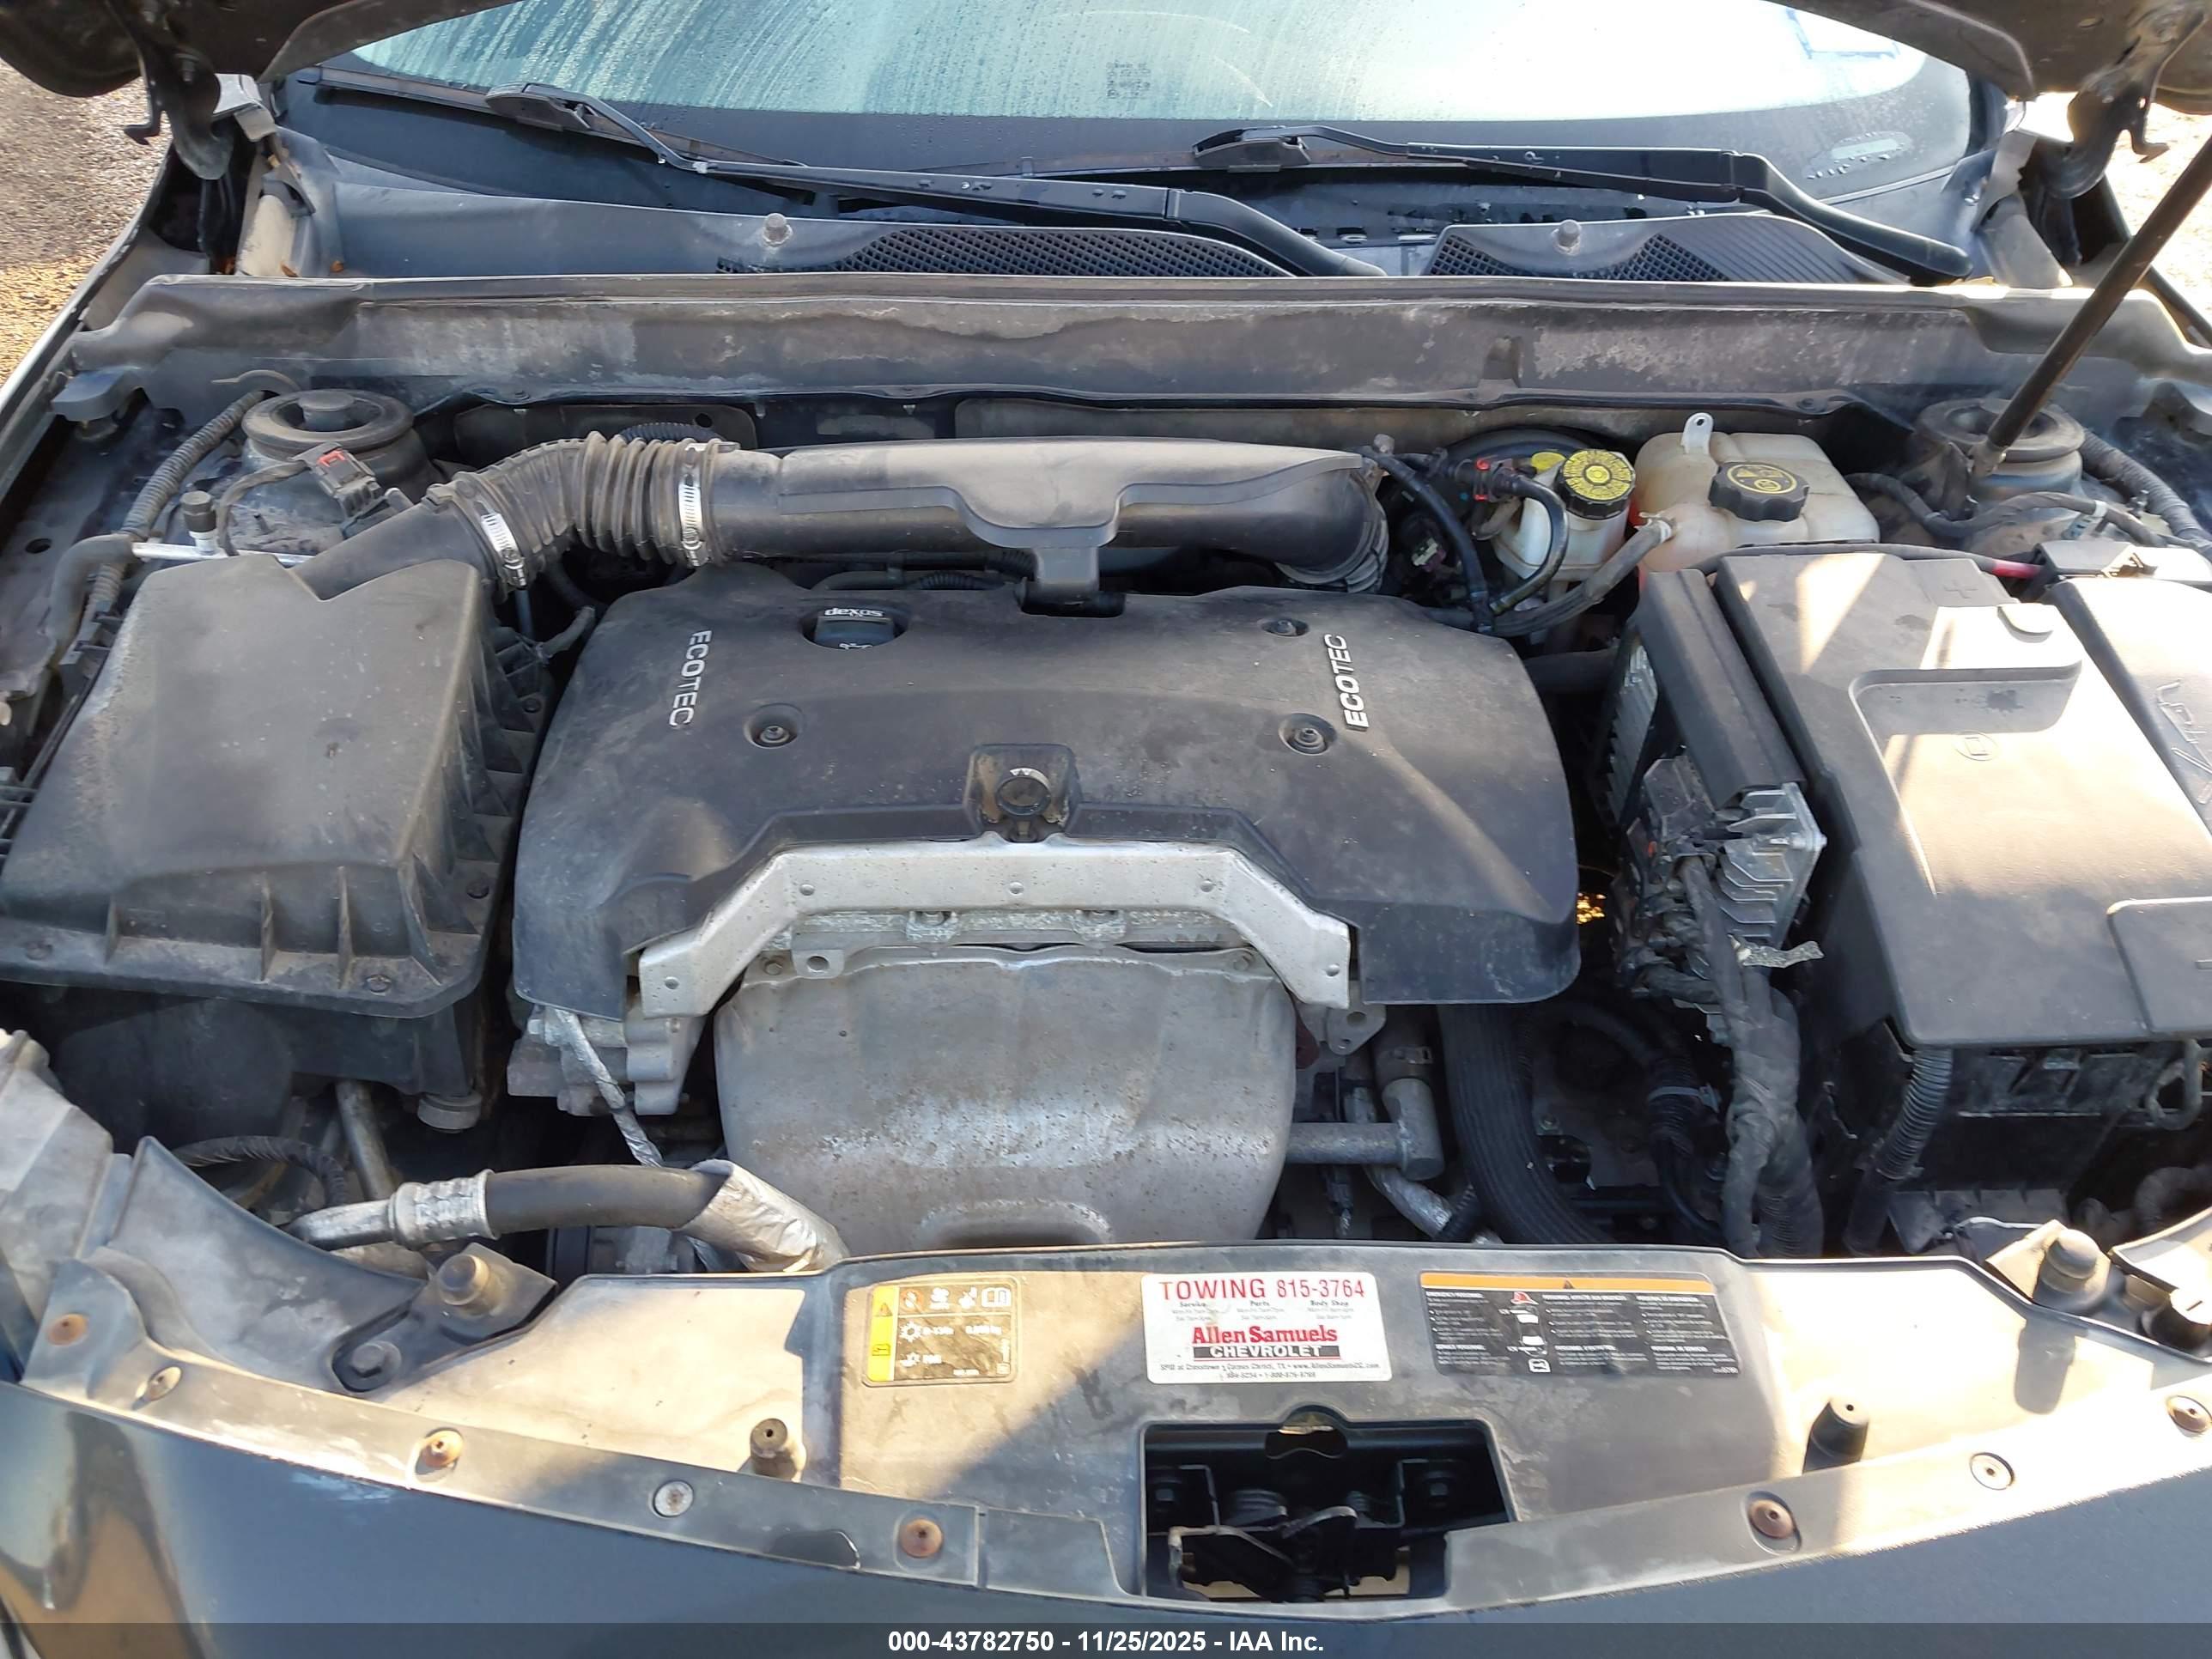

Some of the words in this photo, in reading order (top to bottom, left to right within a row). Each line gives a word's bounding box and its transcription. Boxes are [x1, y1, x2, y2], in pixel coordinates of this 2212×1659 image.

[824, 607, 884, 617] dexos
[669, 630, 712, 726] ECOTEC
[1323, 634, 1369, 728] ECOTEC
[1158, 1279, 1266, 1300] TOWING
[1277, 1279, 1364, 1298] 815-3764
[1192, 1326, 1246, 1344] Allen
[1249, 1324, 1338, 1343] Samuels
[1208, 1345, 1322, 1358] CHEVROLET
